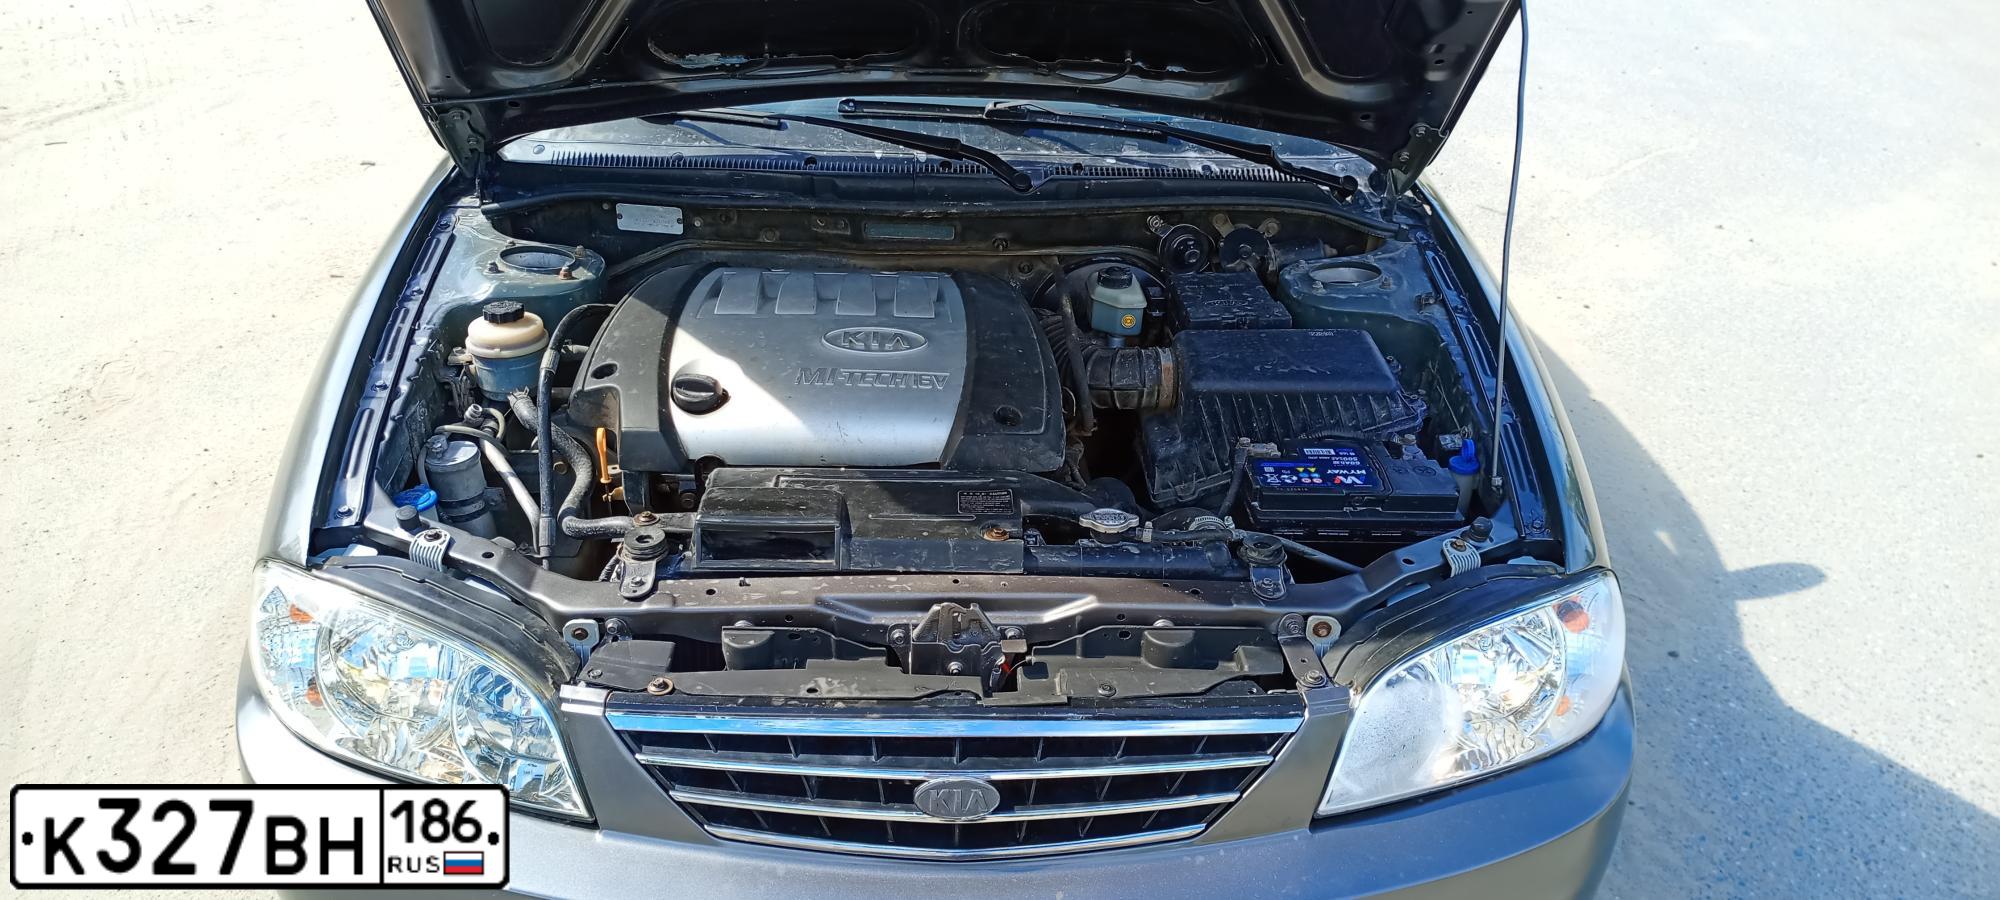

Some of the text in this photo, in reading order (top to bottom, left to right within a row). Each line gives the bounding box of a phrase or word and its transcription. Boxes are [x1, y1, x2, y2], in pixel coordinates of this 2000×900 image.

[841, 330, 911, 350] KIA
[794, 367, 908, 388] MI-TECH
[929, 788, 989, 814] KIA
